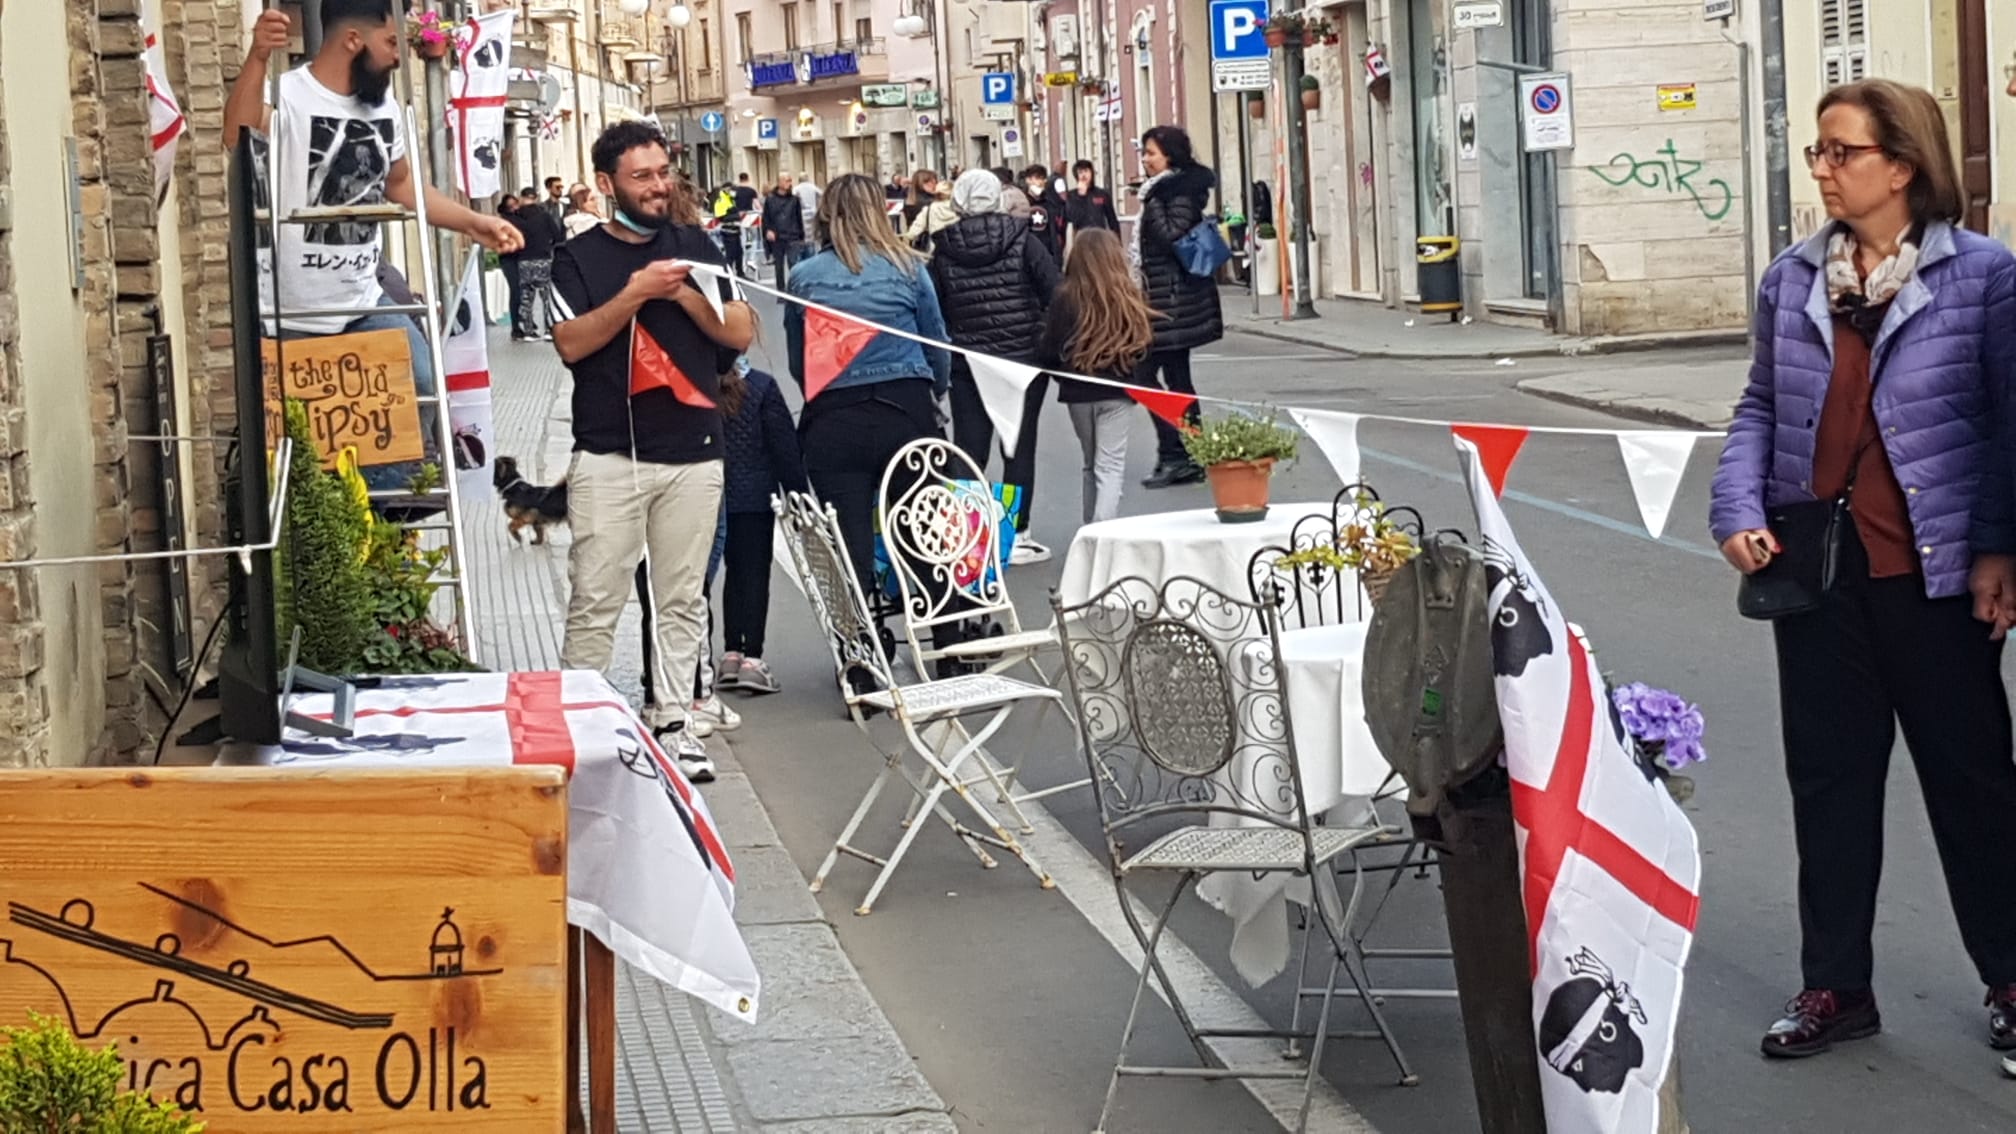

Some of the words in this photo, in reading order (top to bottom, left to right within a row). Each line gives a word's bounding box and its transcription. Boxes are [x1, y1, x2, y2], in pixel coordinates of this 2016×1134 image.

[1224, 7, 1256, 52] P
[988, 77, 1007, 101] P
[761, 121, 773, 137] P
[289, 357, 333, 389] the
[160, 419, 185, 636] OPEN
[227, 1033, 353, 1113] Casa
[375, 1026, 491, 1111] Olla
